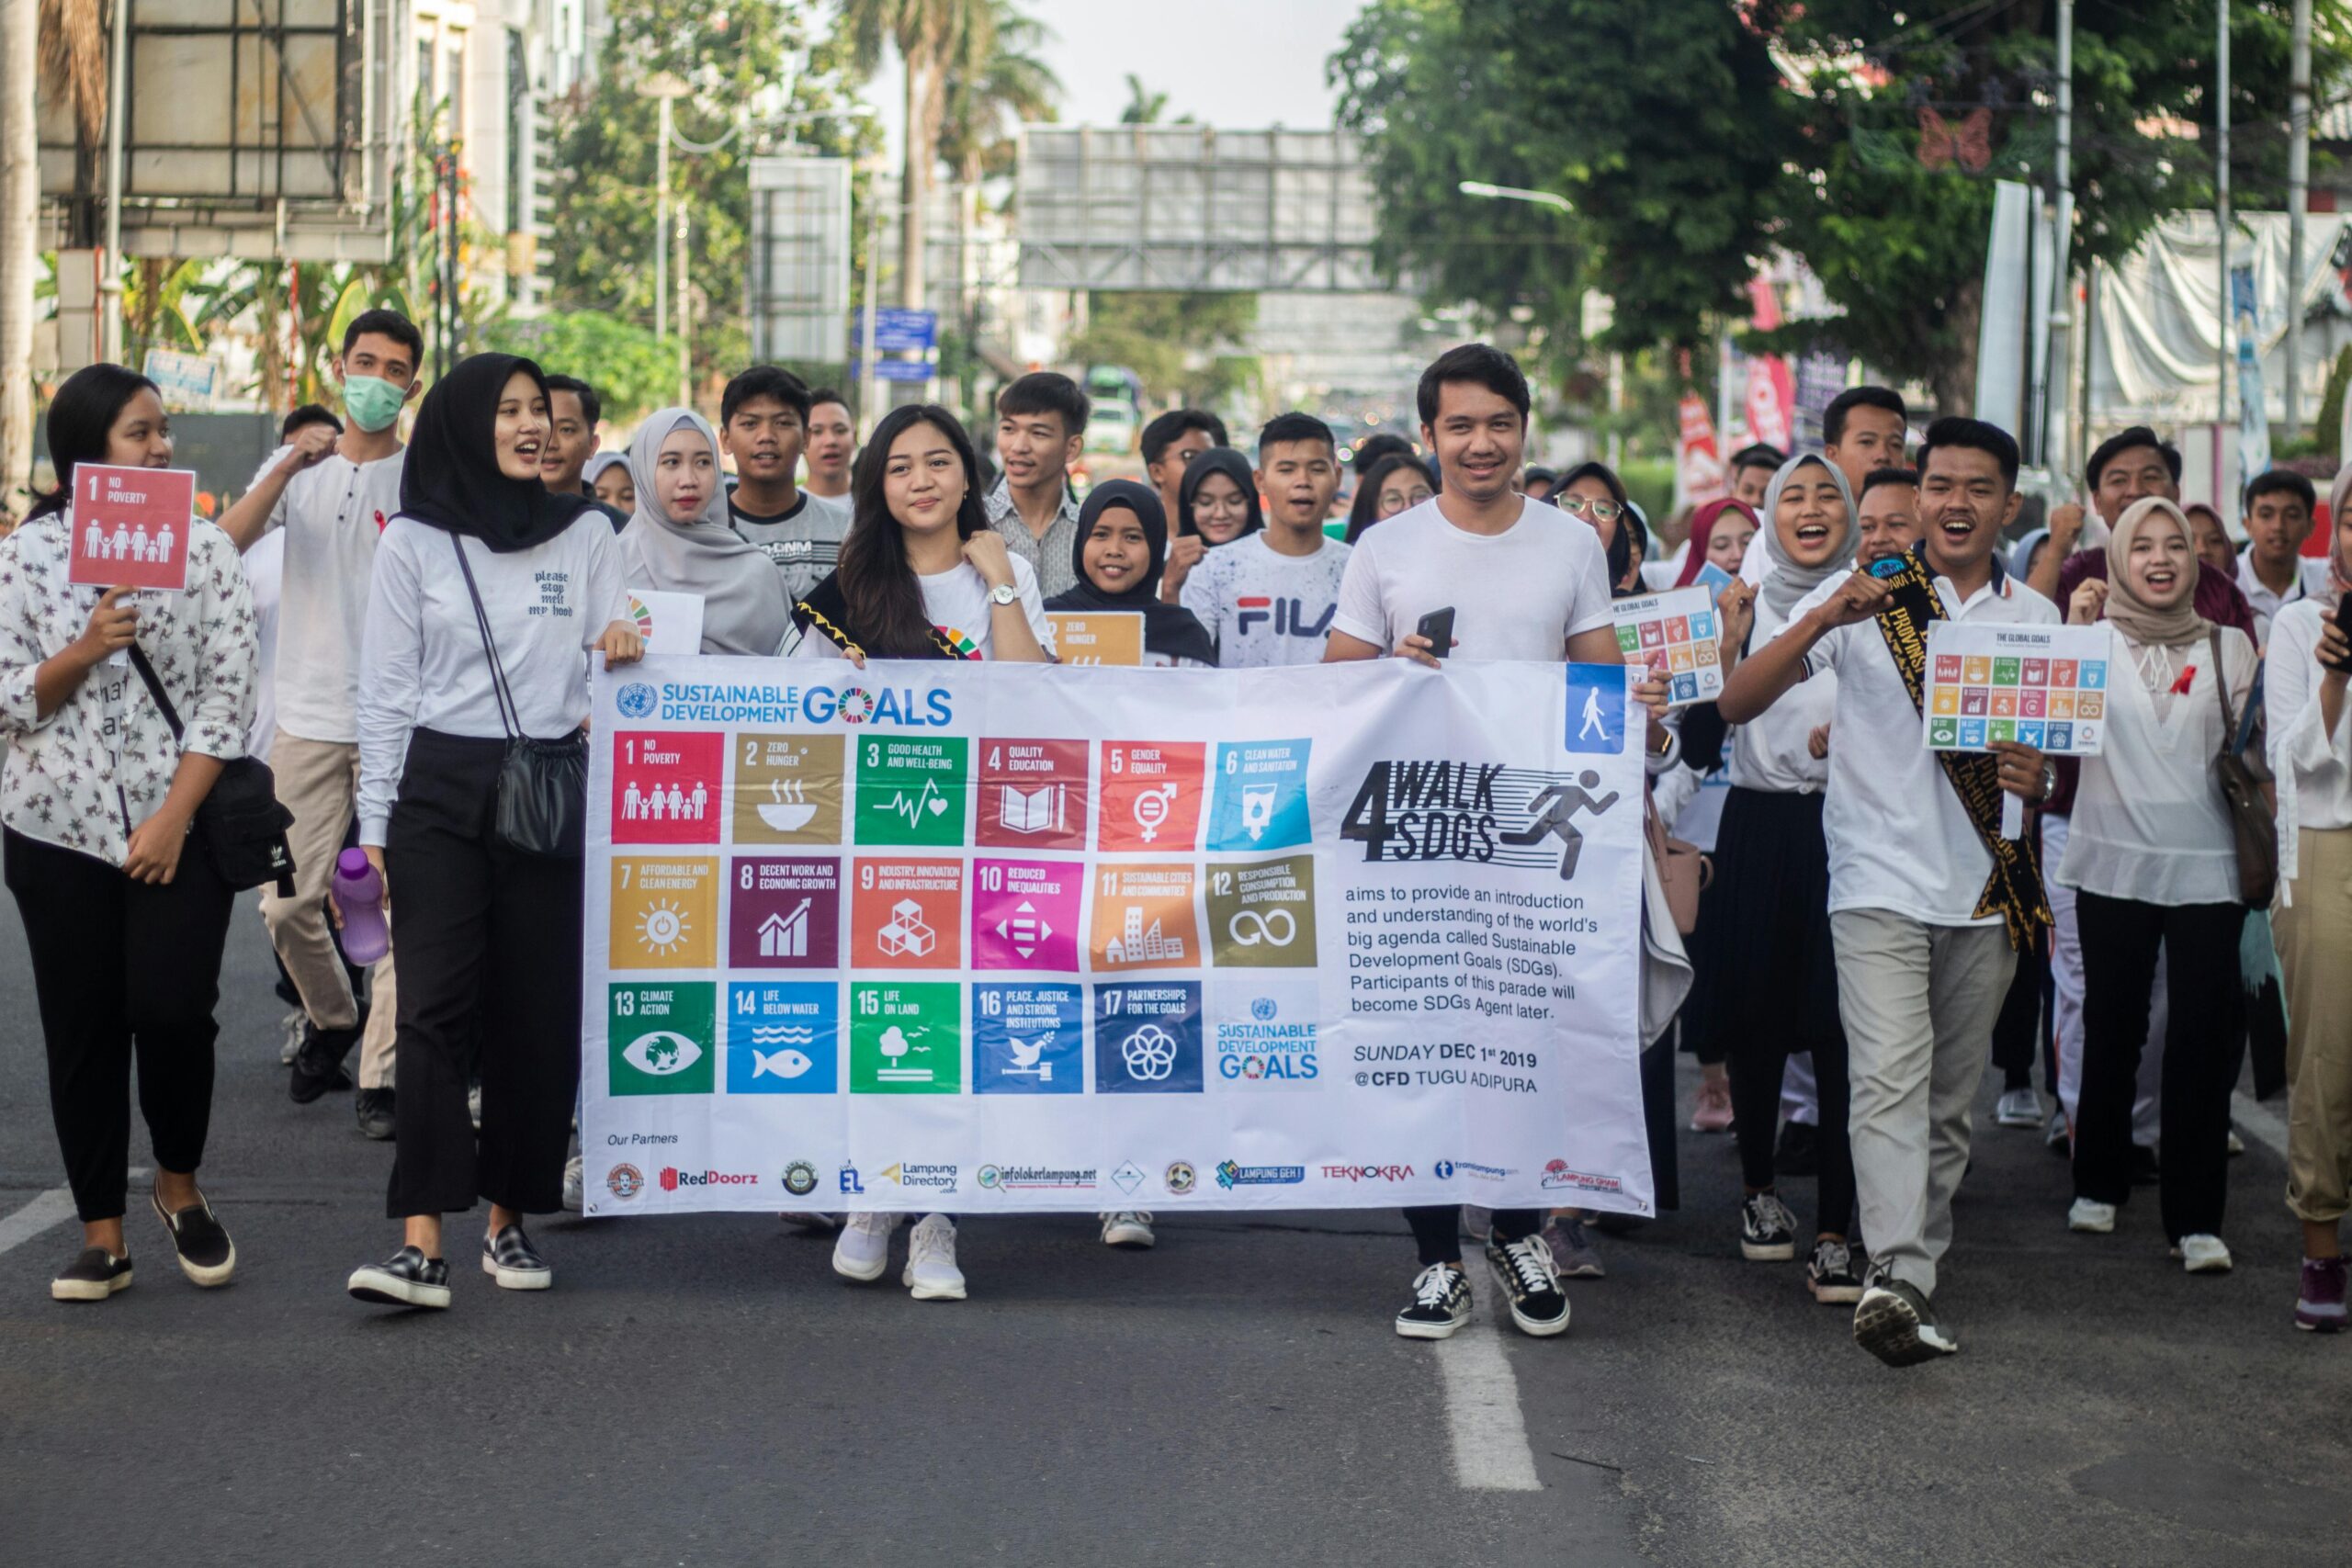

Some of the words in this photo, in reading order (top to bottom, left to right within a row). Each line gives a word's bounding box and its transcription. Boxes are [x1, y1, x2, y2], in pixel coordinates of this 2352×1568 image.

[89, 476, 97, 501] 1
[108, 477, 121, 488] NO
[107, 491, 147, 504] POVERTY
[535, 570, 569, 583] please
[541, 582, 565, 594] stop
[1996, 632, 2007, 641] THE
[2008, 634, 2030, 642] GLOBAL
[2031, 635, 2051, 643] GOALS
[662, 683, 798, 705] SUSTAINABLE
[802, 685, 953, 727] GOALS
[662, 705, 798, 724] DEVELOPMENT
[625, 739, 634, 764] 1
[644, 739, 656, 751] NO
[766, 742, 788, 754] ZERO
[888, 743, 911, 755] GOOD
[912, 745, 943, 756] HEALTH
[643, 752, 681, 765] POVERTY
[745, 741, 757, 766] 2
[867, 743, 880, 767] 3
[988, 746, 1001, 772] 4
[1009, 746, 1043, 760] QUALITY
[1131, 749, 1160, 761] GENDER
[1244, 749, 1267, 761] CLEAN
[1268, 748, 1291, 760] WATER
[766, 754, 799, 767] HUNGER
[887, 756, 904, 768] AND
[905, 757, 953, 770] WELL-BEING
[1009, 759, 1054, 773] EDUCATION
[1111, 749, 1123, 774] 5
[1130, 761, 1167, 774] EQUALITY
[1226, 750, 1238, 775] 6
[1243, 762, 1259, 773] AND
[1259, 760, 1298, 773] SANITATION
[1393, 761, 1506, 811] WALK
[1340, 761, 1396, 861] 4
[1393, 811, 1496, 863] SDGS
[621, 864, 631, 889] 7
[640, 864, 691, 876] AFFORDABLE
[693, 864, 708, 875] AND
[741, 864, 753, 890] 8
[760, 864, 790, 876] DECENT
[791, 864, 815, 876] WORK
[816, 864, 833, 876] AND
[878, 865, 916, 877] INDUSTRY,
[917, 866, 960, 878] INNOVATION
[1008, 867, 1046, 881] REDUCED
[1238, 864, 1291, 882] RESPONSIBLE
[639, 878, 666, 889] CLEAN
[667, 878, 697, 889] ENERGY
[760, 878, 800, 890] ECONOMIC
[801, 878, 836, 890] GROWTH
[861, 865, 875, 890] 9
[878, 879, 895, 890] AND
[895, 879, 958, 890] INFRASTRUCTURE
[979, 865, 1001, 891] 10
[1102, 872, 1117, 897] 11
[1123, 872, 1170, 883] SUSTAINABLE
[1170, 872, 1193, 883] CITIES
[1213, 872, 1232, 897] 12
[1239, 876, 1296, 893] CONSUMPTION
[1007, 880, 1060, 895] INEQUALITIES
[1122, 886, 1136, 897] AND
[1241, 892, 1259, 905] AND
[1259, 889, 1306, 902] PRODUCTION
[1346, 886, 1385, 901] aims
[1391, 886, 1407, 901] to
[1412, 885, 1470, 903] provide
[1475, 890, 1491, 902] an
[1495, 889, 1584, 909] introduction
[1347, 908, 1377, 923] and
[1383, 908, 1493, 929] understanding
[1497, 912, 1510, 927] of
[1514, 914, 1534, 931] the
[1539, 918, 1598, 932] world's
[1348, 931, 1373, 949] big
[1378, 930, 1441, 948] agenda
[1446, 930, 1487, 946] called
[1492, 932, 1576, 955] Sustainable
[1350, 952, 1459, 970] Development
[1464, 952, 1502, 970] Goals
[1507, 957, 1563, 979] (SDGs).
[1351, 974, 1449, 992] Participants
[1454, 973, 1468, 987] of
[1472, 976, 1495, 991] this
[1499, 981, 1546, 998] parade
[1552, 985, 1575, 999] will
[640, 990, 673, 1002] CLIMATE
[763, 990, 779, 1001] LIFE
[884, 990, 899, 1001] LIFE
[1006, 991, 1035, 1002] PEACE,
[1035, 991, 1069, 1002] JUSTICE
[1127, 989, 1187, 1001] PARTNERSHIPS
[615, 991, 634, 1016] 13
[640, 1003, 670, 1016] ACTION
[735, 990, 756, 1015] 14
[763, 1003, 790, 1015] BELOW
[791, 1003, 820, 1015] WATER
[858, 990, 879, 1015] 15
[884, 1003, 896, 1015] ON
[898, 1003, 920, 1015] LAND
[979, 991, 1001, 1016] 16
[1006, 1004, 1024, 1015] AND
[1024, 1004, 1057, 1015] STRONG
[1103, 990, 1122, 1015] 17
[1127, 1003, 1143, 1014] FOR
[1144, 1003, 1159, 1014] THE
[1159, 1002, 1186, 1014] GOALS
[1351, 998, 1418, 1012] become
[1423, 994, 1471, 1010] SDGs
[1476, 997, 1513, 1017] Agent
[1517, 1003, 1555, 1019] later.
[1006, 1017, 1061, 1029] INSTITUTIONS
[1218, 1024, 1317, 1038] SUSTAINABLE
[1218, 1040, 1317, 1053] DEVELOPMENT
[1353, 1044, 1434, 1062] SUNDAY
[1440, 1043, 1476, 1059] DEC
[1480, 1047, 1496, 1062] 1st
[1499, 1051, 1537, 1068] 2019
[1219, 1054, 1318, 1079] GOALS
[1416, 1070, 1467, 1085] TUGU
[1471, 1073, 1537, 1093] ADIPURA
[607, 1134, 628, 1146] Our
[632, 1134, 678, 1145] Partners
[903, 1162, 957, 1176] Lampung
[1001, 1166, 1097, 1185] infolokerlampung.net
[1239, 1168, 1278, 1179] LAMPUNG
[1321, 1165, 1414, 1182] TEKNOKRA
[679, 1170, 759, 1186] RedDoorz
[903, 1175, 957, 1189] Directory
